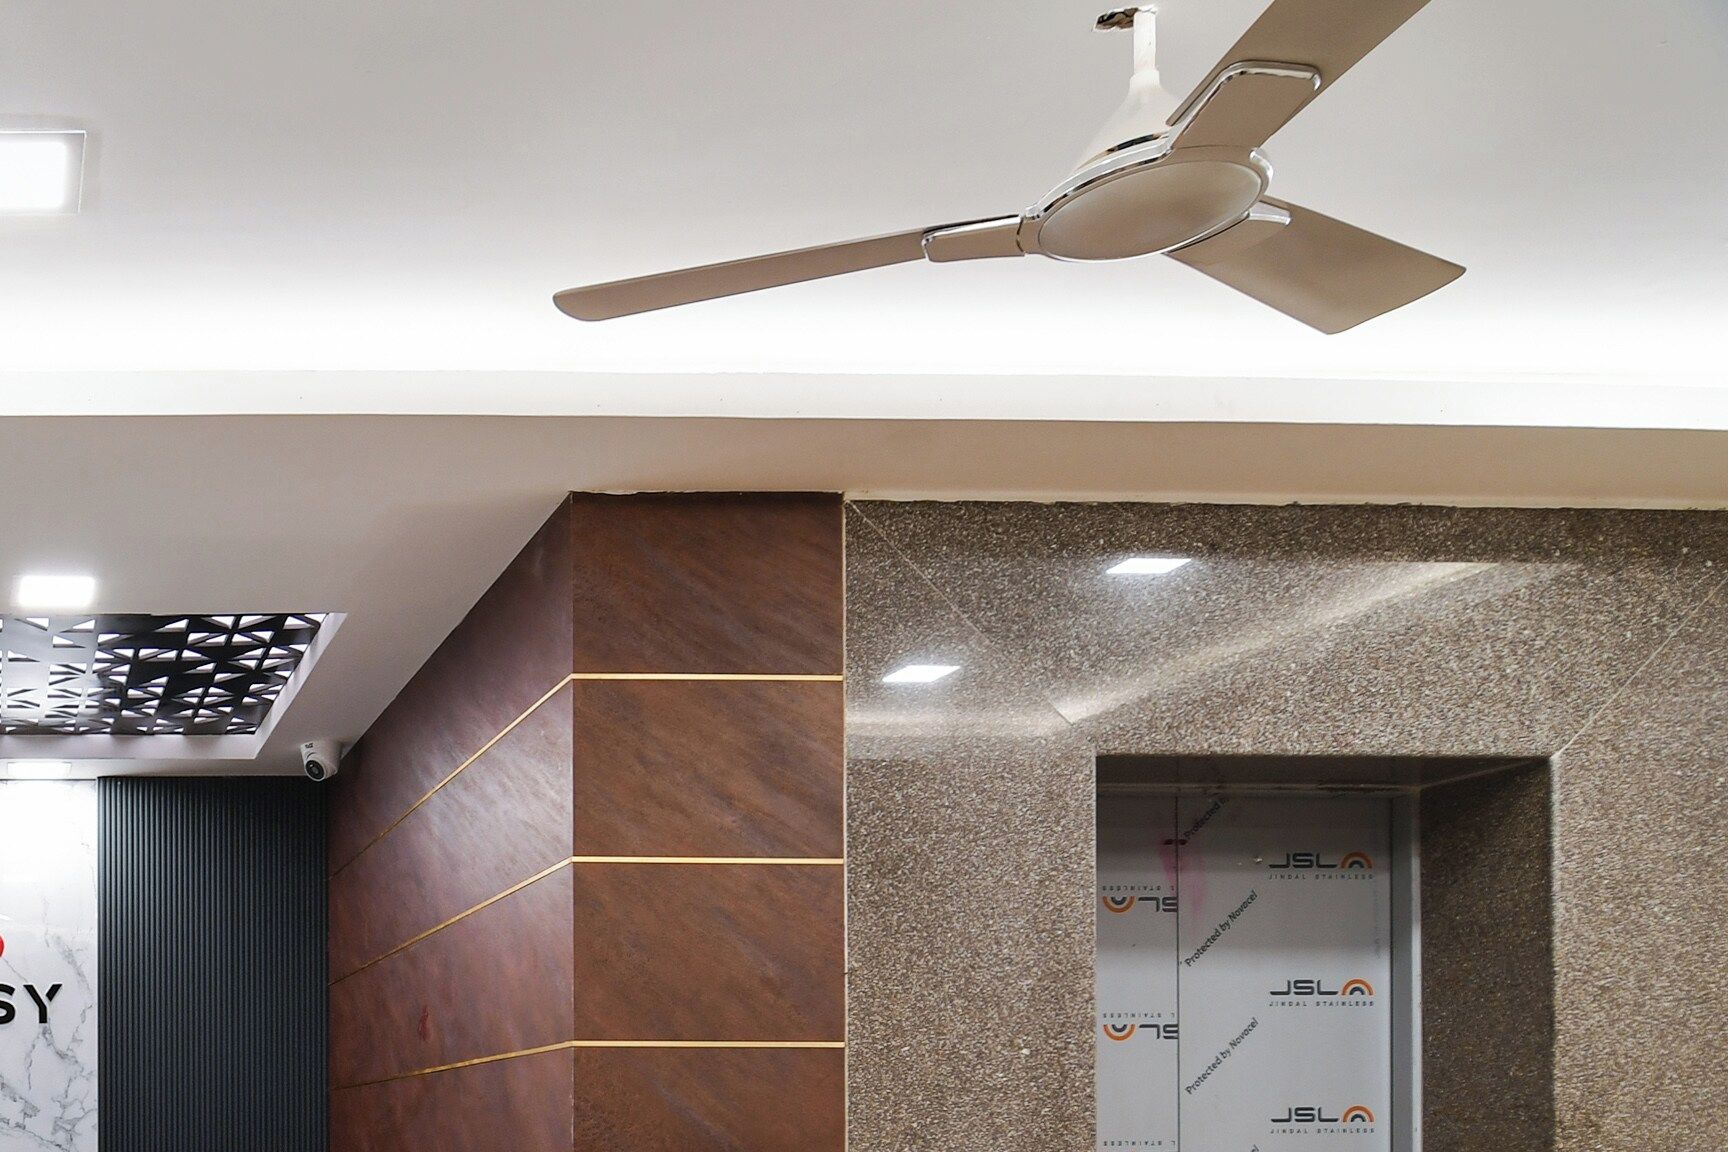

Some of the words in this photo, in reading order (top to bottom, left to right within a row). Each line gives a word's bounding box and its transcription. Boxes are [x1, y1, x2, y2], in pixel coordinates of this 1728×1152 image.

[1268, 852, 1338, 869] JSL
[1184, 928, 1222, 967] Protected
[1219, 920, 1231, 931] by
[1228, 889, 1258, 922] Novacel
[1269, 979, 1339, 996] JSL
[1185, 1056, 1223, 1094] Protected
[1220, 1048, 1232, 1059] by
[1229, 1017, 1258, 1050] Novacel
[1270, 1106, 1340, 1123] JSL
